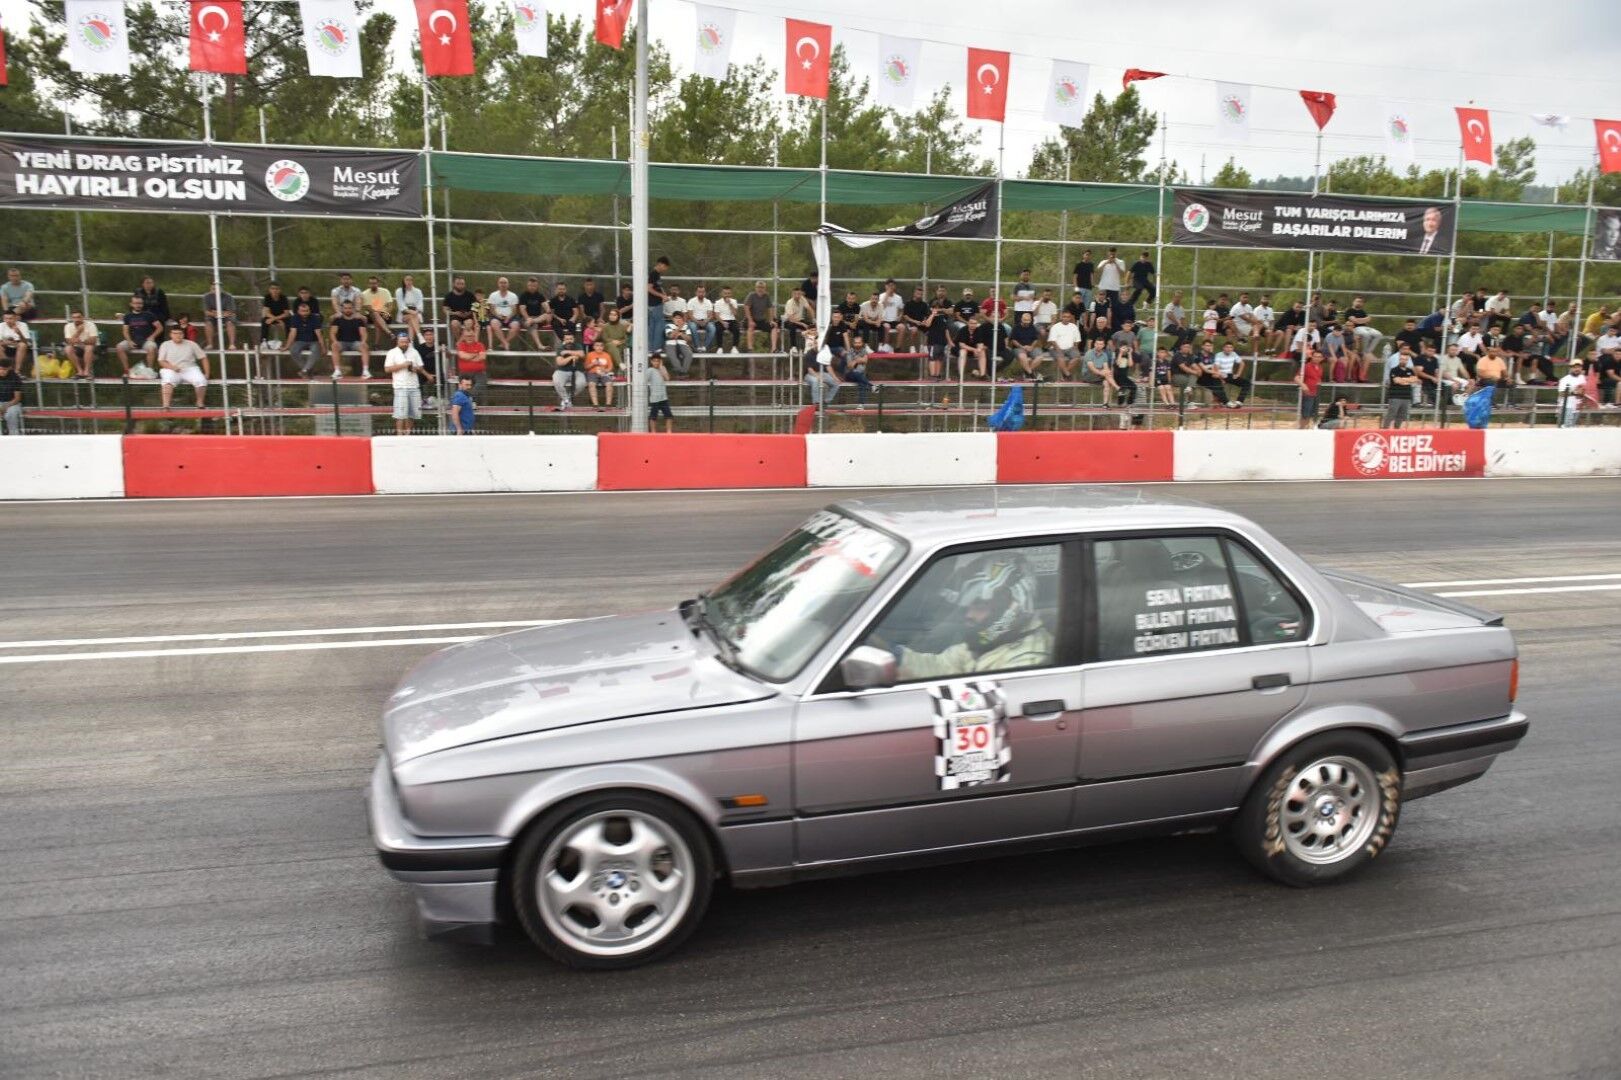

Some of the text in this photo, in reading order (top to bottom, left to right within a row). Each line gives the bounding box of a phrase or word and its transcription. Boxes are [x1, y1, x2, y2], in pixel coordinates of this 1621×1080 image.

[13, 149, 243, 175] YENİ DRAG PİSTİMİZ
[333, 166, 400, 184] Mesut
[15, 173, 138, 197] HAYIRLI
[143, 177, 247, 201] OLSUN
[1222, 207, 1264, 221] Mesut
[1272, 222, 1351, 238] BAŞARILAR
[1389, 435, 1434, 453] KEPEZ
[1388, 450, 1467, 473] BELEDİYESİ
[957, 726, 988, 751] 30
